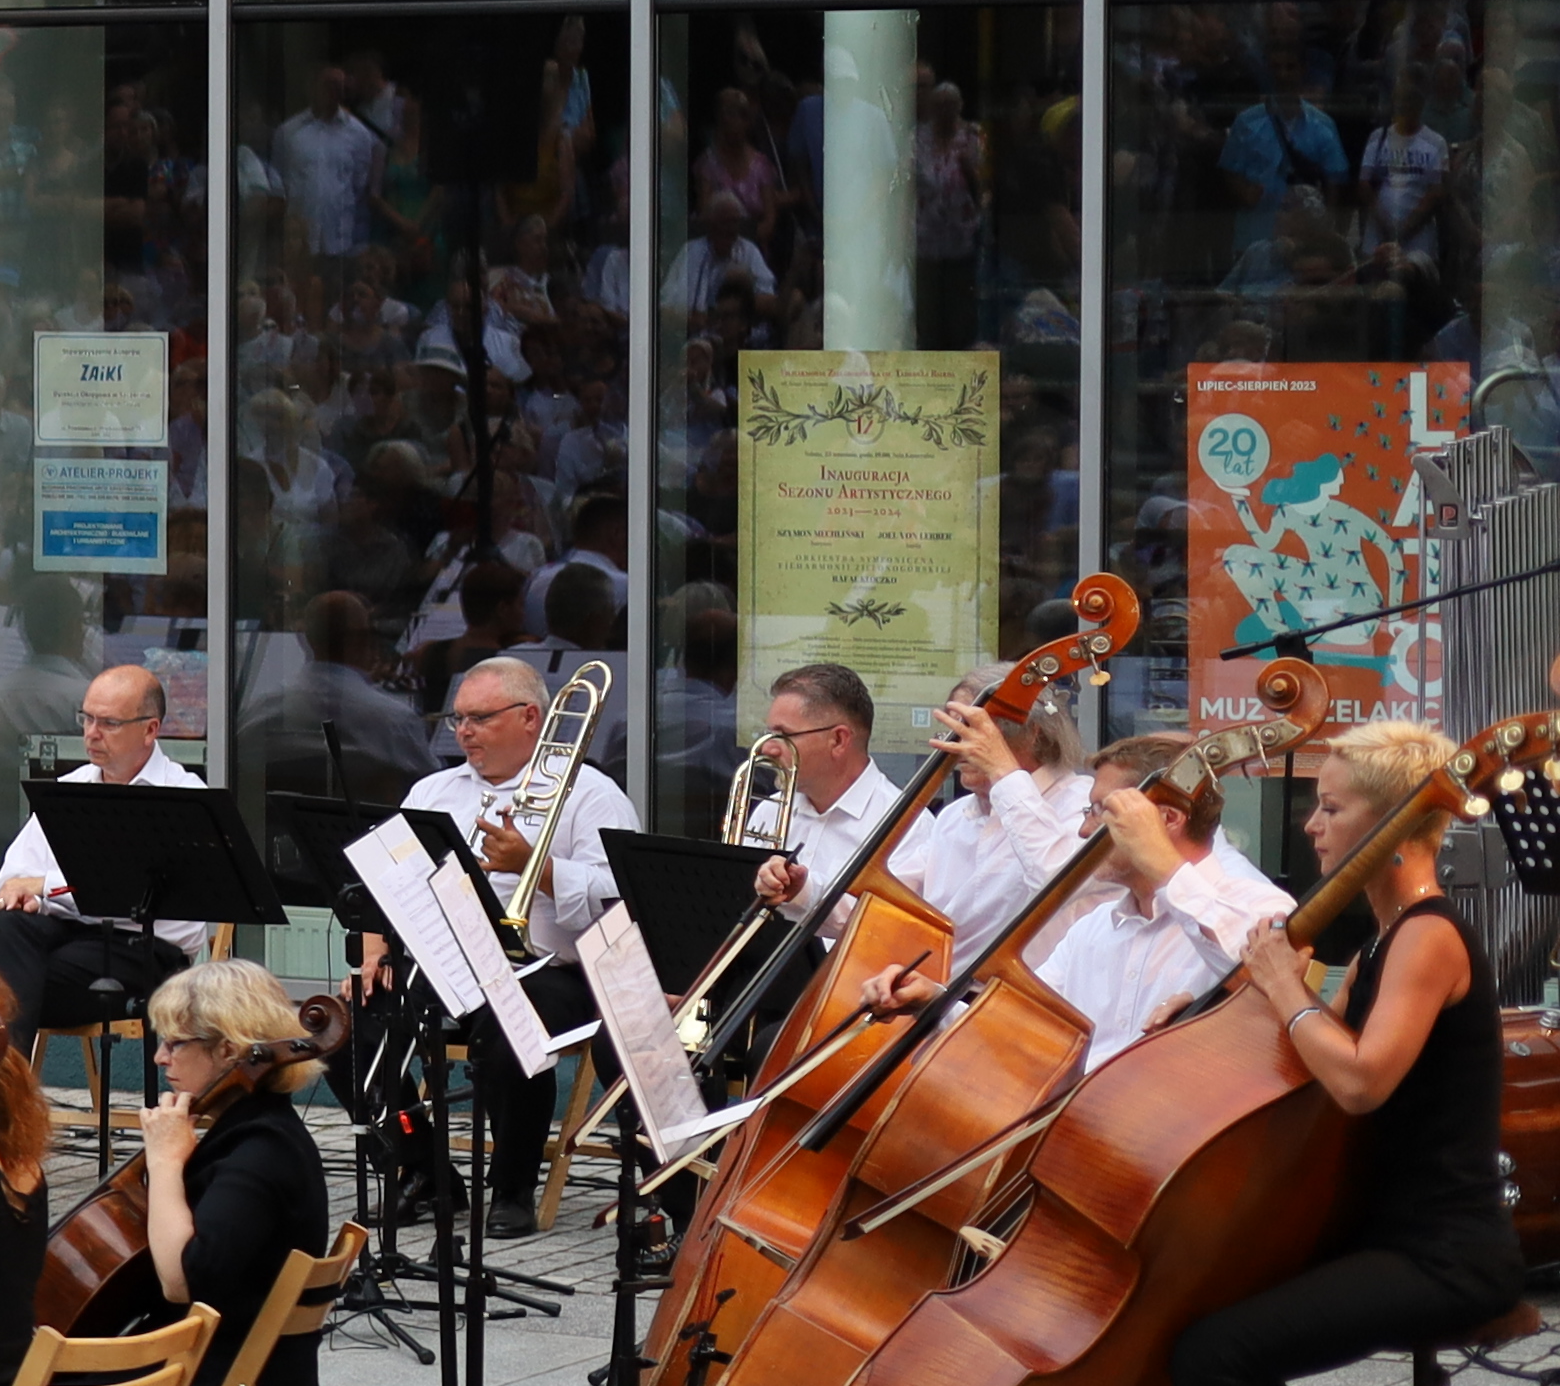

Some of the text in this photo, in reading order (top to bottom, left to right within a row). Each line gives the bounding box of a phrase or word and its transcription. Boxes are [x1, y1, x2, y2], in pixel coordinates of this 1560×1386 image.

[1197, 379, 1317, 392] LIPIEC-SIERPIEŃ 2023
[1207, 426, 1257, 457] 20
[1223, 450, 1256, 476] lat
